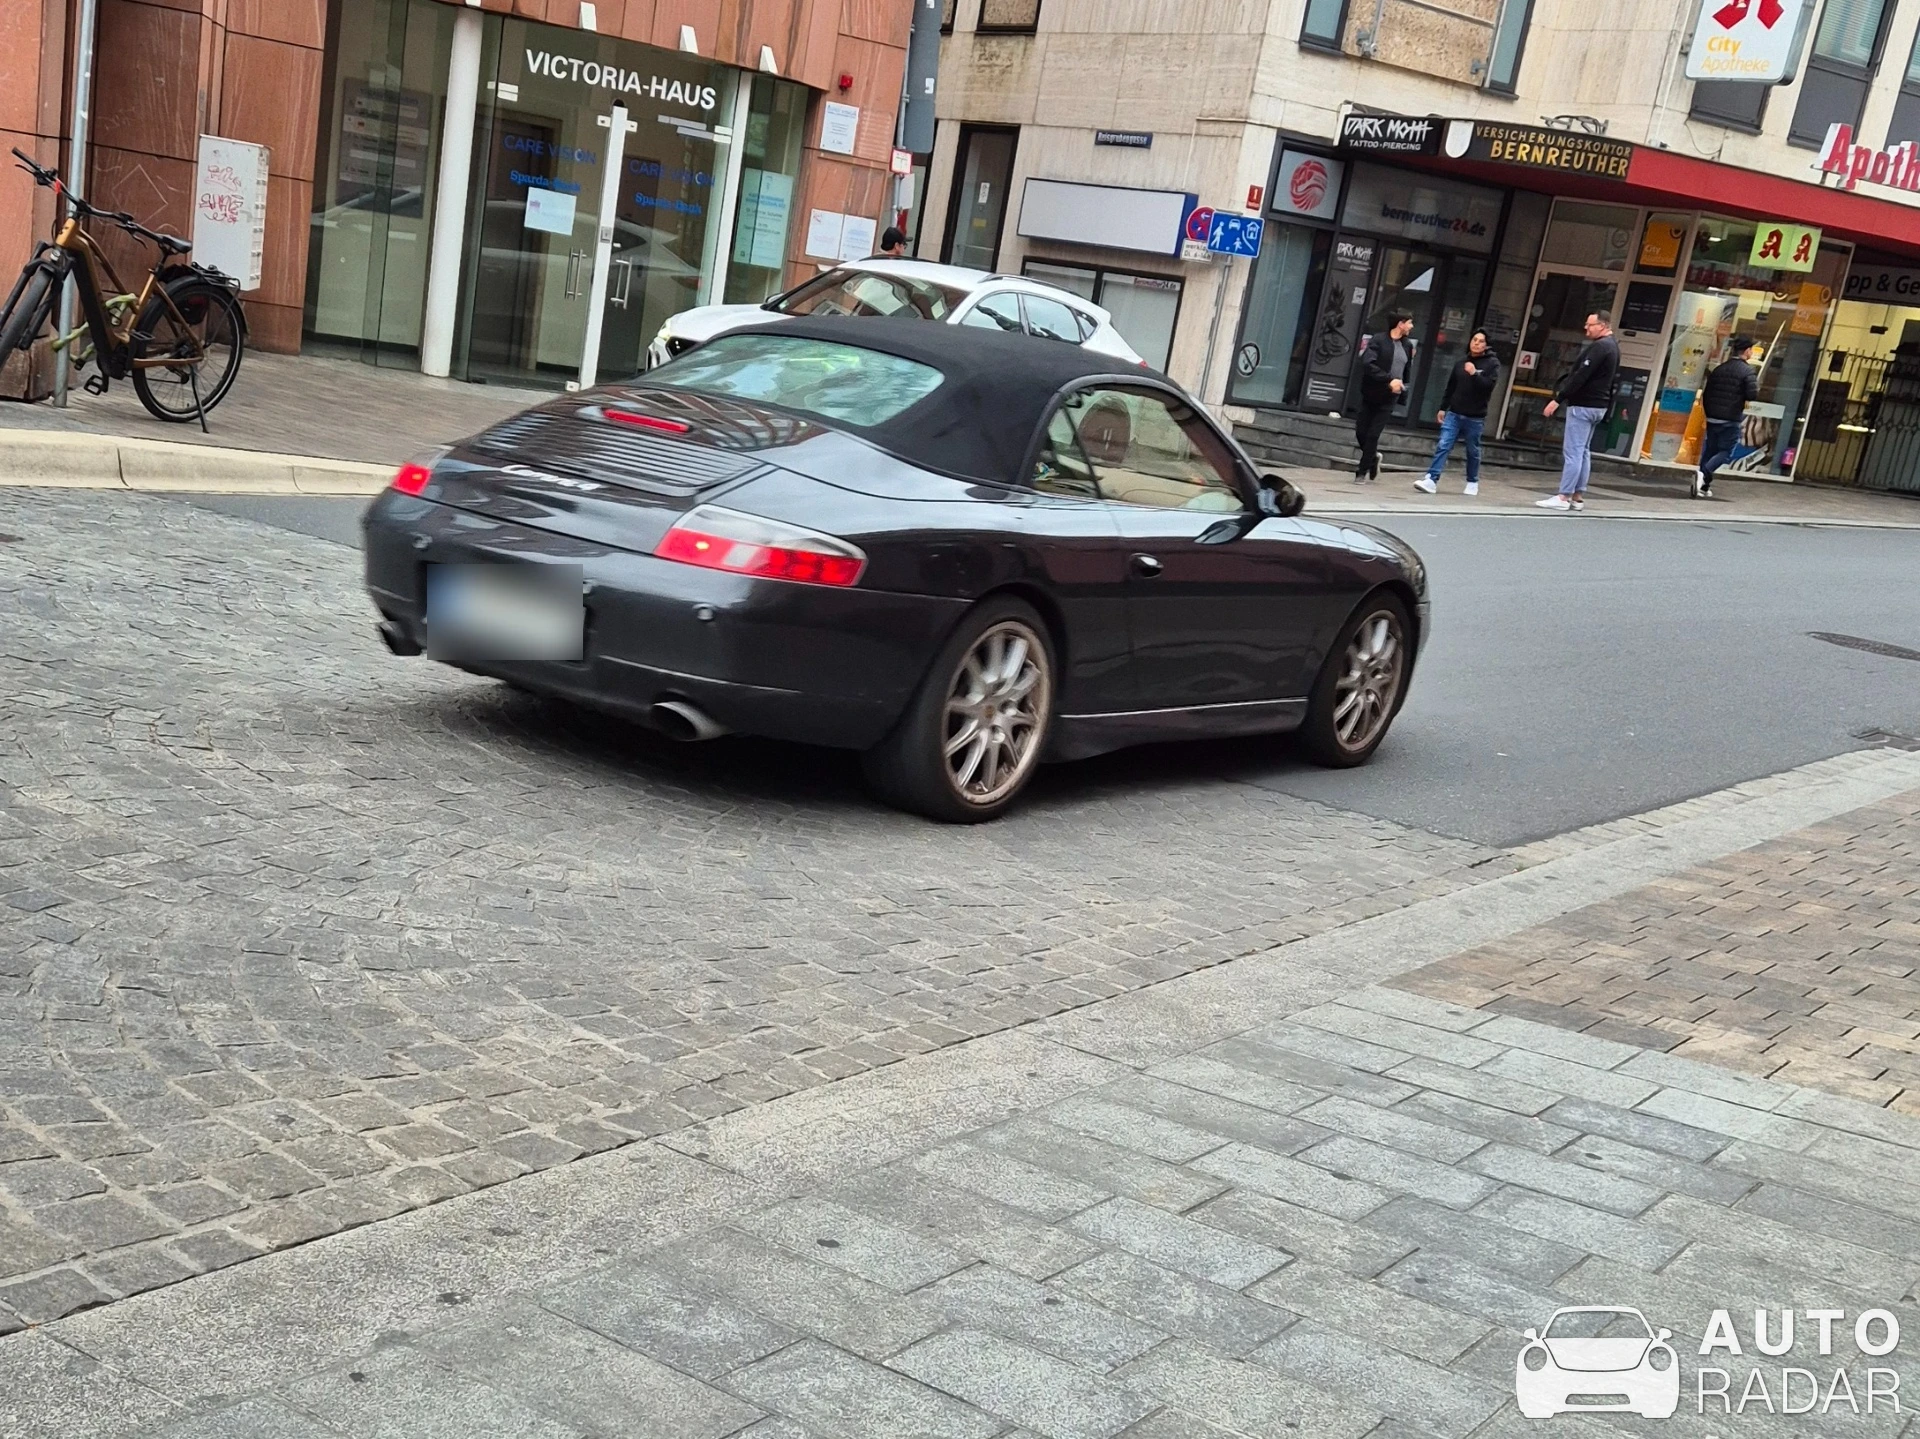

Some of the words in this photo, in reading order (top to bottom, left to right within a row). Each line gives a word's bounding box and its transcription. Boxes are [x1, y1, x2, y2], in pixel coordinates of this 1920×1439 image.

[1706, 36, 1741, 55] City
[1701, 56, 1770, 74] Apotheke
[526, 49, 716, 110] VICTORIA-HAUS
[1344, 117, 1386, 139] DARK
[503, 135, 545, 157] CARE
[547, 142, 597, 165] VISION
[1476, 126, 1631, 158] VERSICHERUNGSKONTOR
[629, 160, 665, 179] CARE
[1491, 139, 1629, 177] BERNREUTHER
[510, 168, 581, 192] Sparda-Bank
[1382, 203, 1486, 237] bernreuther24.de
